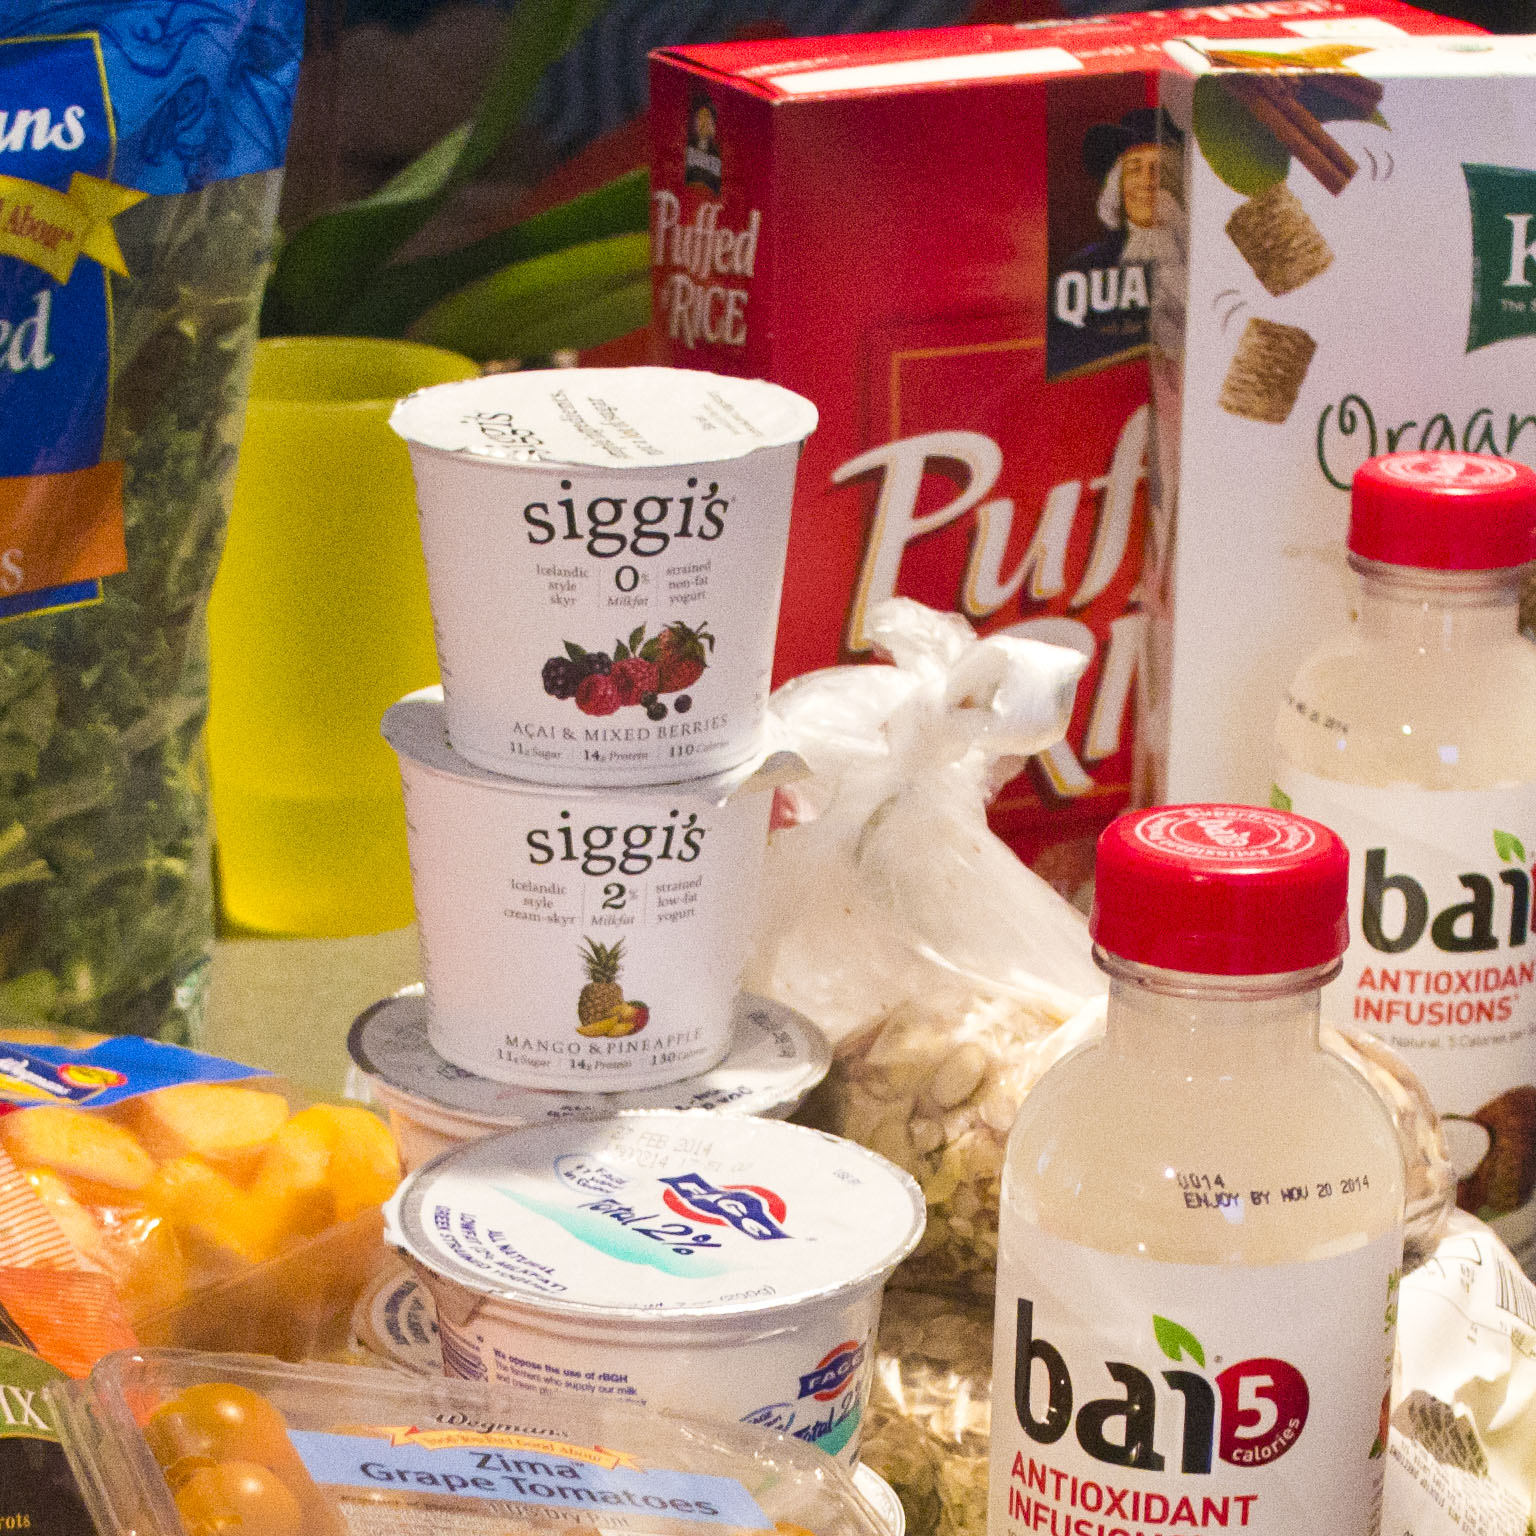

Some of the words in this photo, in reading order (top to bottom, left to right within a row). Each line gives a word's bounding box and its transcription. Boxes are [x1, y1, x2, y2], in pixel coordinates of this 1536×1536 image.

[655, 190, 761, 280] Puffed
[663, 272, 749, 349] RICE
[1056, 264, 1152, 331] QUA
[523, 477, 730, 558] siggi's
[666, 561, 712, 575] strained
[668, 575, 709, 589] non-fat
[562, 729, 578, 742] &
[584, 729, 651, 743] MIXED
[657, 714, 729, 740] BERRIES
[525, 809, 707, 876] siggi's
[1361, 846, 1533, 956] bai
[1352, 995, 1516, 1029] INFUSIONS
[505, 1034, 582, 1056] MANGO
[588, 1041, 603, 1055] &
[607, 1028, 703, 1055] PINEAPPLE
[578, 1198, 660, 1227] Total
[632, 1222, 723, 1256] 2%
[509, 1355, 543, 1371] oppose
[545, 1364, 561, 1375] the
[563, 1369, 582, 1379] use
[585, 1371, 596, 1380] of
[565, 1381, 596, 1394] supply
[599, 1385, 614, 1394] our
[617, 1385, 638, 1396] milk
[1014, 1296, 1216, 1475] bai
[1234, 1374, 1279, 1440] 5
[433, 1411, 568, 1438] Wegmans
[1231, 1416, 1301, 1464] calories
[360, 1461, 495, 1493] Grape
[503, 1475, 720, 1518] Tomatoes
[469, 1451, 583, 1481] Zima
[1010, 1450, 1259, 1528] ANTIOXIDANT
